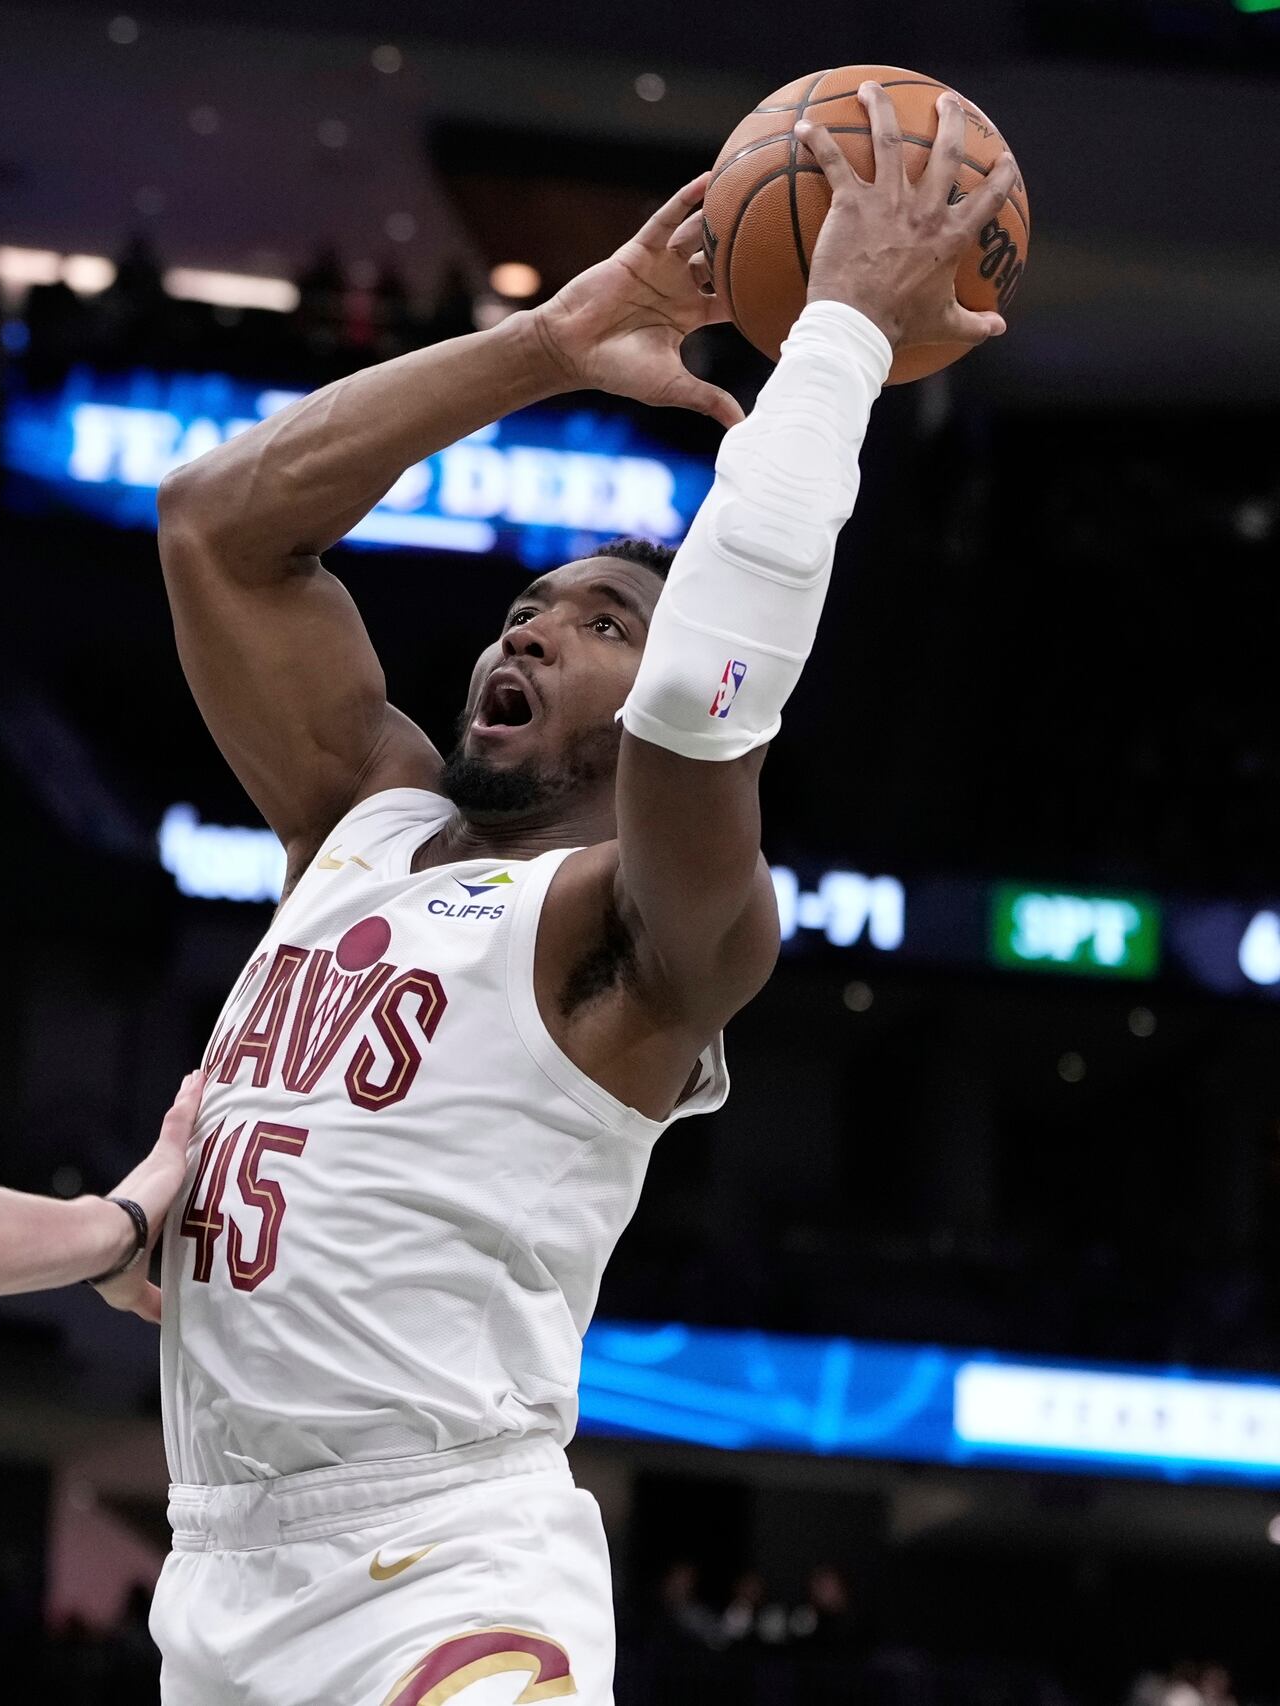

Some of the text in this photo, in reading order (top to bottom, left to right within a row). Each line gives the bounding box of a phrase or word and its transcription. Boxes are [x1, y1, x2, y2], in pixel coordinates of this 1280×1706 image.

[442, 445, 680, 535] DEER
[427, 899, 505, 920] CLIFFS
[180, 1116, 309, 1292] 45
